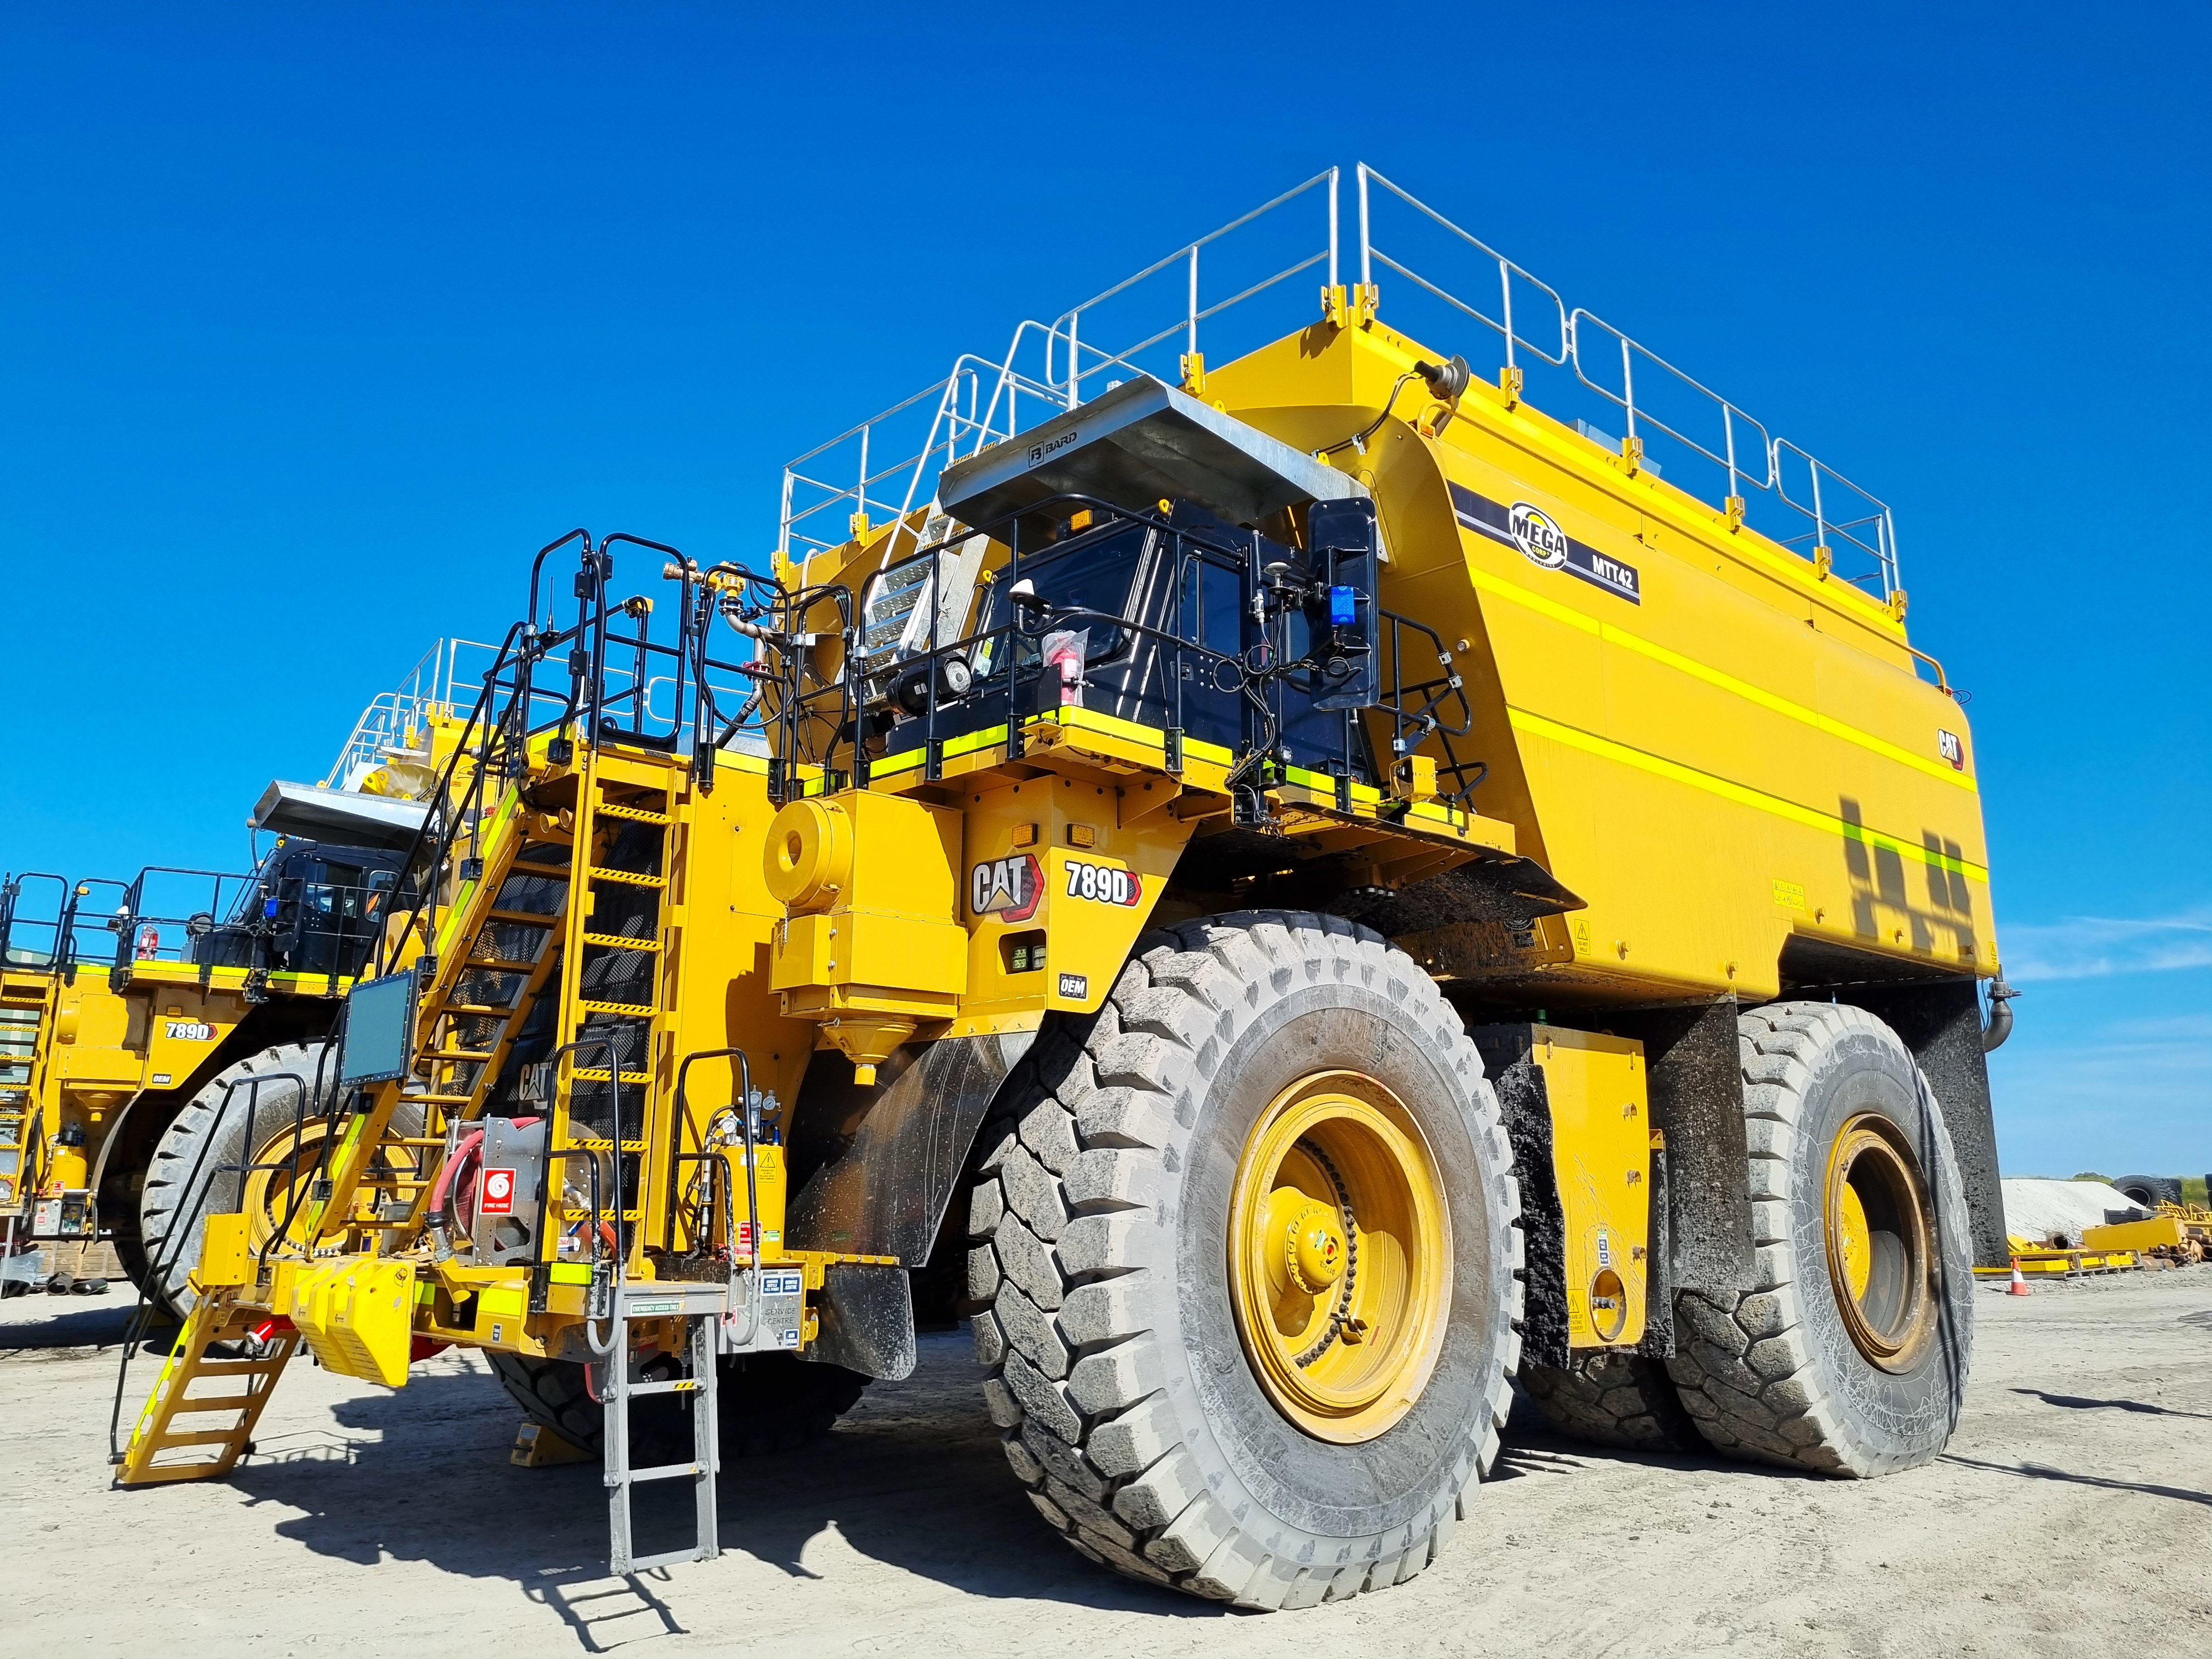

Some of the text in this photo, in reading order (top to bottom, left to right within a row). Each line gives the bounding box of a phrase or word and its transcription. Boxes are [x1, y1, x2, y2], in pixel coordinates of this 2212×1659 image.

[1045, 431, 1077, 455] BARD
[1512, 514, 1566, 557] MEGA
[1592, 554, 1634, 590] MTT42
[1938, 729, 1958, 762] CAT
[973, 856, 1027, 913] CAT
[1066, 862, 1128, 904] 789D
[1060, 978, 1086, 994] OEM
[166, 1022, 209, 1040] 789D
[519, 1062, 549, 1100] CAT
[765, 1307, 797, 1316] SERVICE
[767, 1317, 794, 1325] CENTRE
